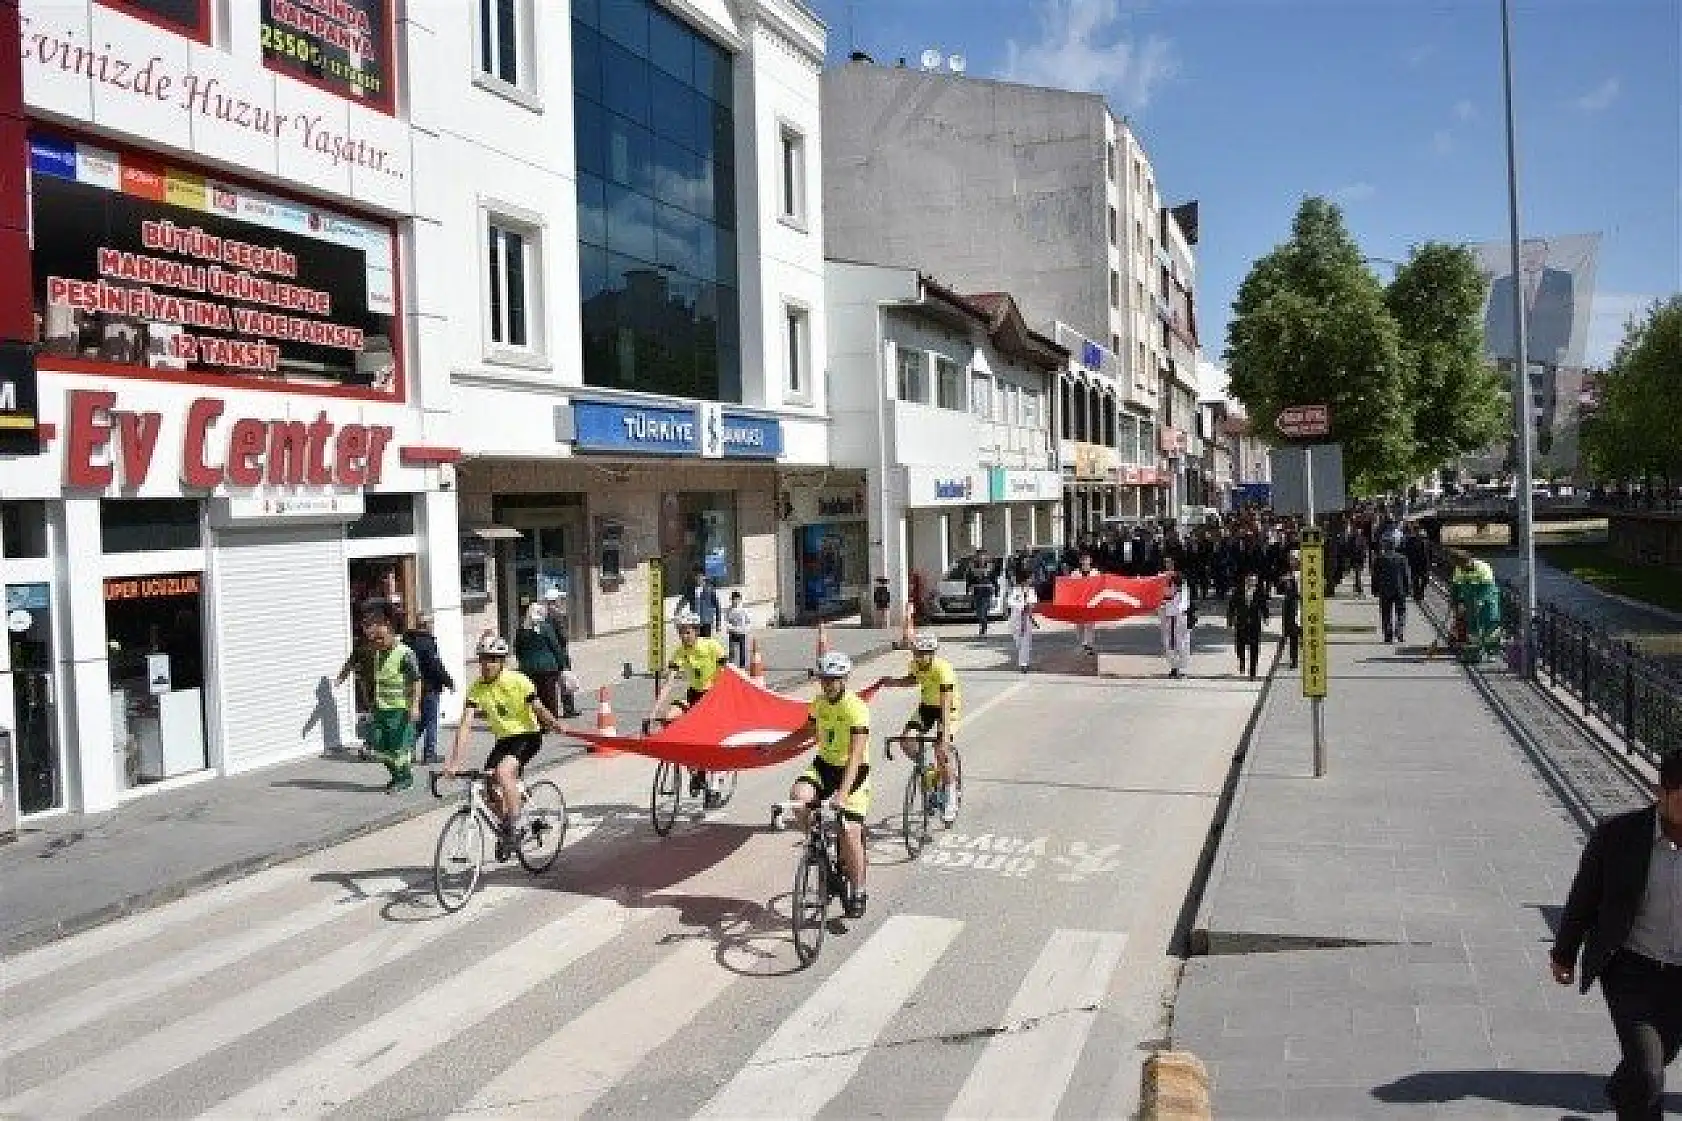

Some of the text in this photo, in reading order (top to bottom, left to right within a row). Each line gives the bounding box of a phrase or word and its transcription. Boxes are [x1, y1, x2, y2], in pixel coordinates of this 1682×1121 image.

[181, 75, 289, 139] Huzur
[142, 219, 222, 263] BÜTÜN
[97, 246, 206, 293] MARKALI
[170, 333, 280, 372] 12 TAKSİT
[183, 397, 394, 488] Center
[623, 412, 693, 441] TÜRKİYE
